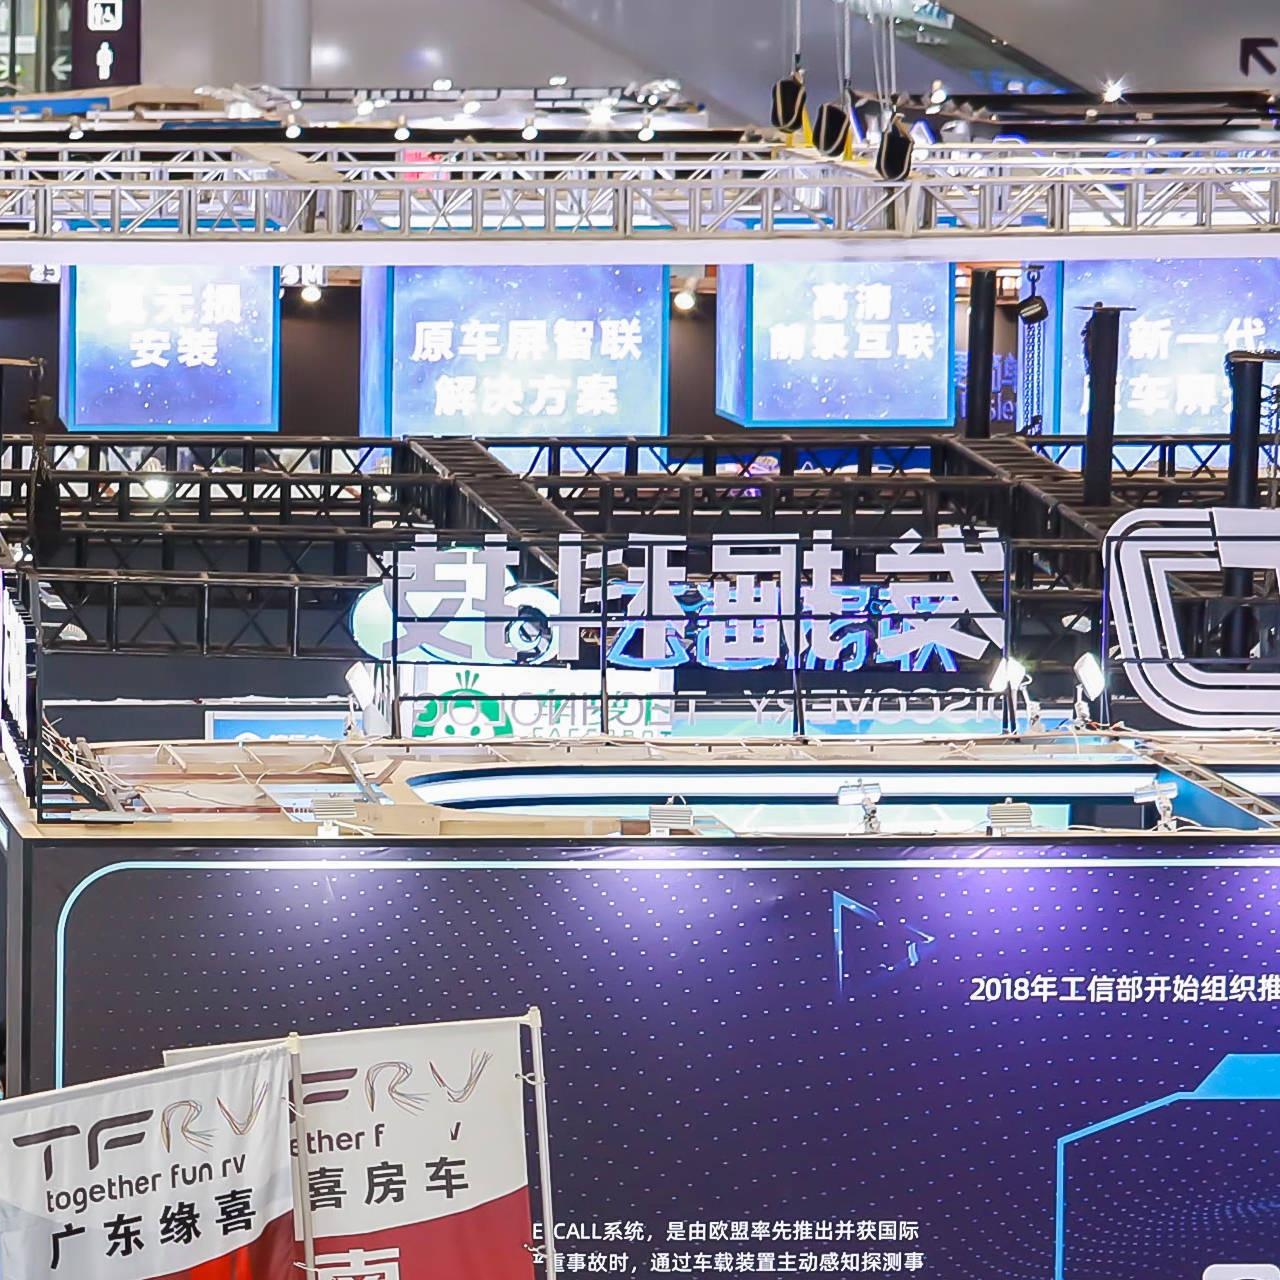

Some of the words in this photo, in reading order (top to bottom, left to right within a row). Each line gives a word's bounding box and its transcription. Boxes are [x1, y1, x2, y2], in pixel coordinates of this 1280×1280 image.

[129, 327, 219, 369] 安装
[46, 1171, 163, 1214] together
[169, 1161, 214, 1190] fun
[220, 1153, 247, 1179] rv
[48, 1187, 257, 1270] 广东缘喜
